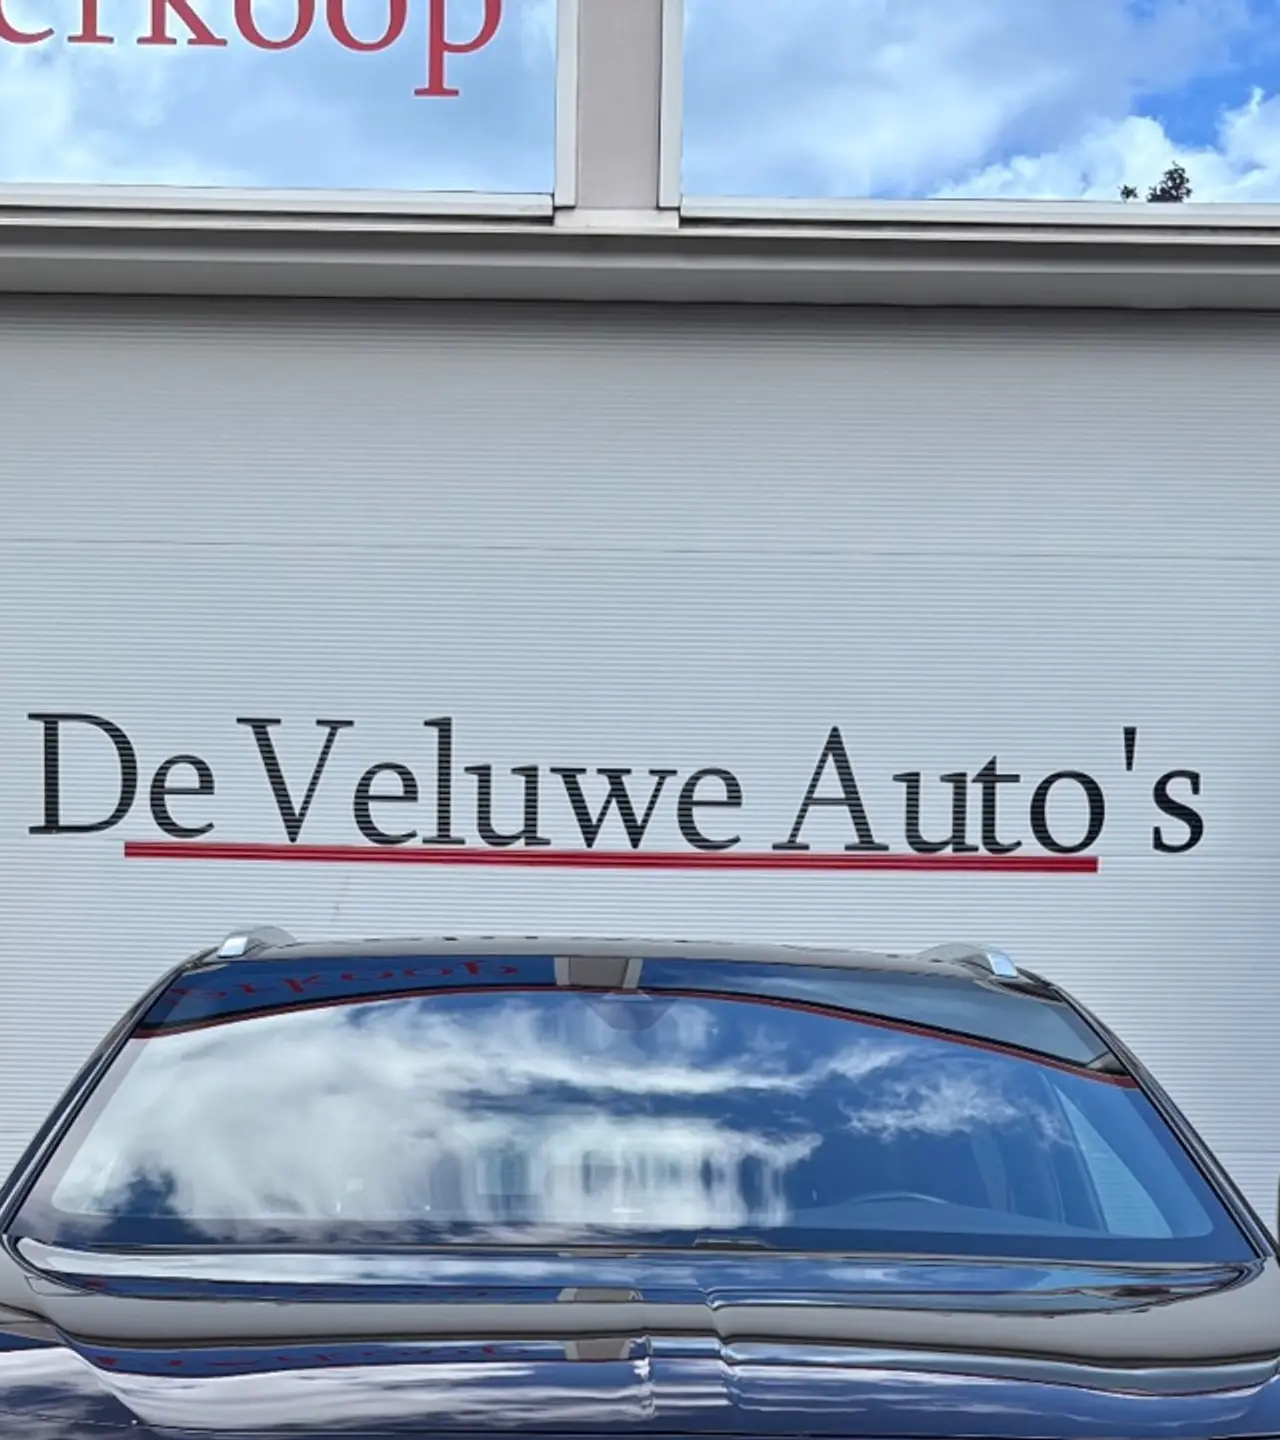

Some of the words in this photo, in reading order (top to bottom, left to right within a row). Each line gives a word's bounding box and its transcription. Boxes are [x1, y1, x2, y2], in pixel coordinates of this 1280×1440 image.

[27, 712, 216, 841] De
[236, 716, 744, 851] Veluwe
[771, 725, 1205, 856] Auto's
